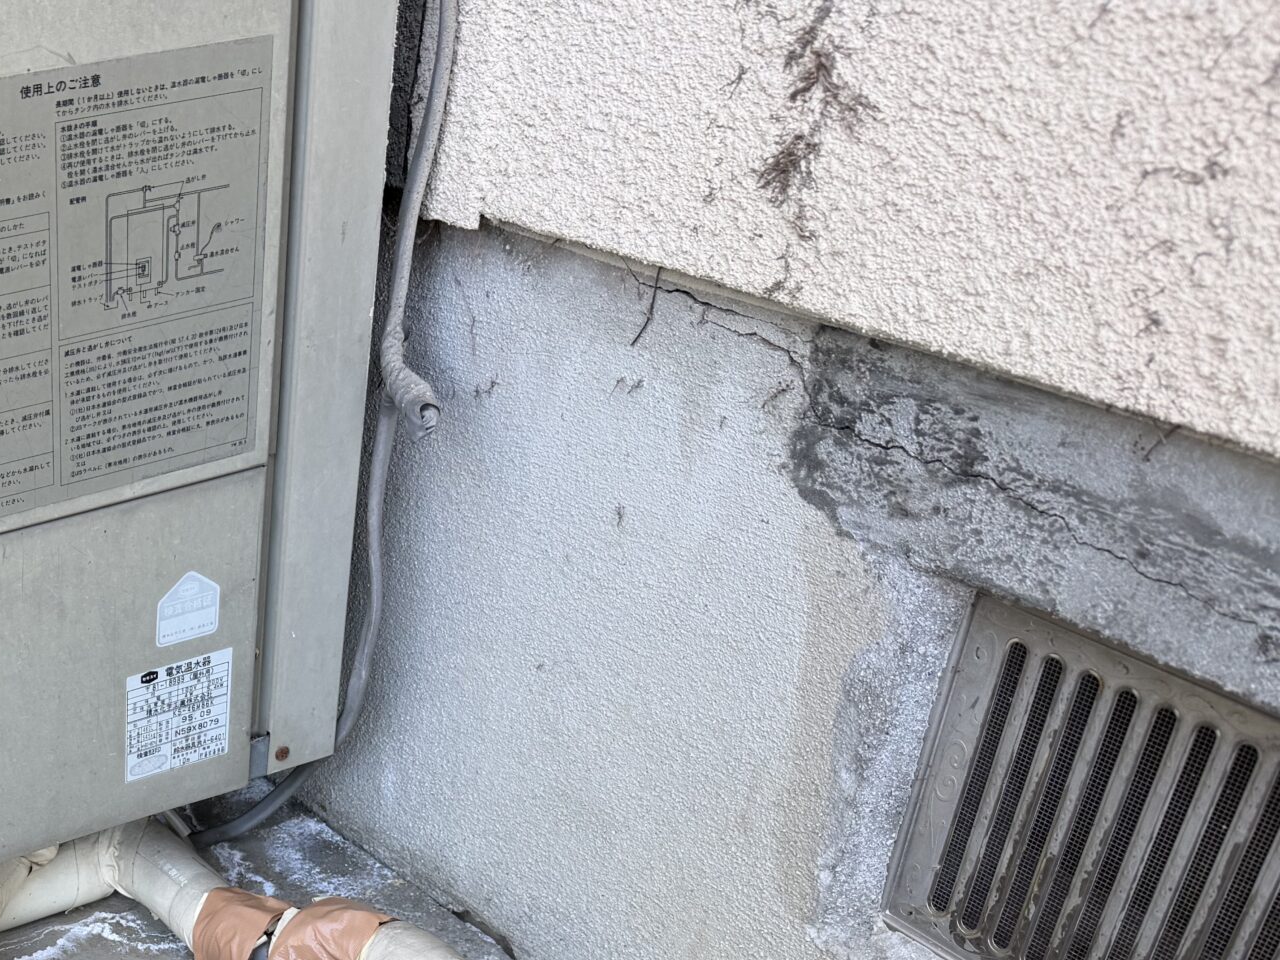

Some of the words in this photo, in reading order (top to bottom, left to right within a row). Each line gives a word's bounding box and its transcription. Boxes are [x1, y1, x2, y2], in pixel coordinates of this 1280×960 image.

[19, 73, 101, 99] 使用上のご注意
[60, 119, 97, 133] 水抜きの手順
[224, 216, 244, 226] シャワー
[71, 277, 104, 290] テストボタン
[175, 285, 205, 298] アンカー固定
[71, 293, 103, 307] 排水トラップ
[152, 300, 168, 309] アース
[64, 335, 132, 357] 減圧弁と逃がし弁について
[165, 655, 210, 678] 電気温水器
[181, 708, 211, 723] 95.09
[174, 717, 219, 737] N59X8079
